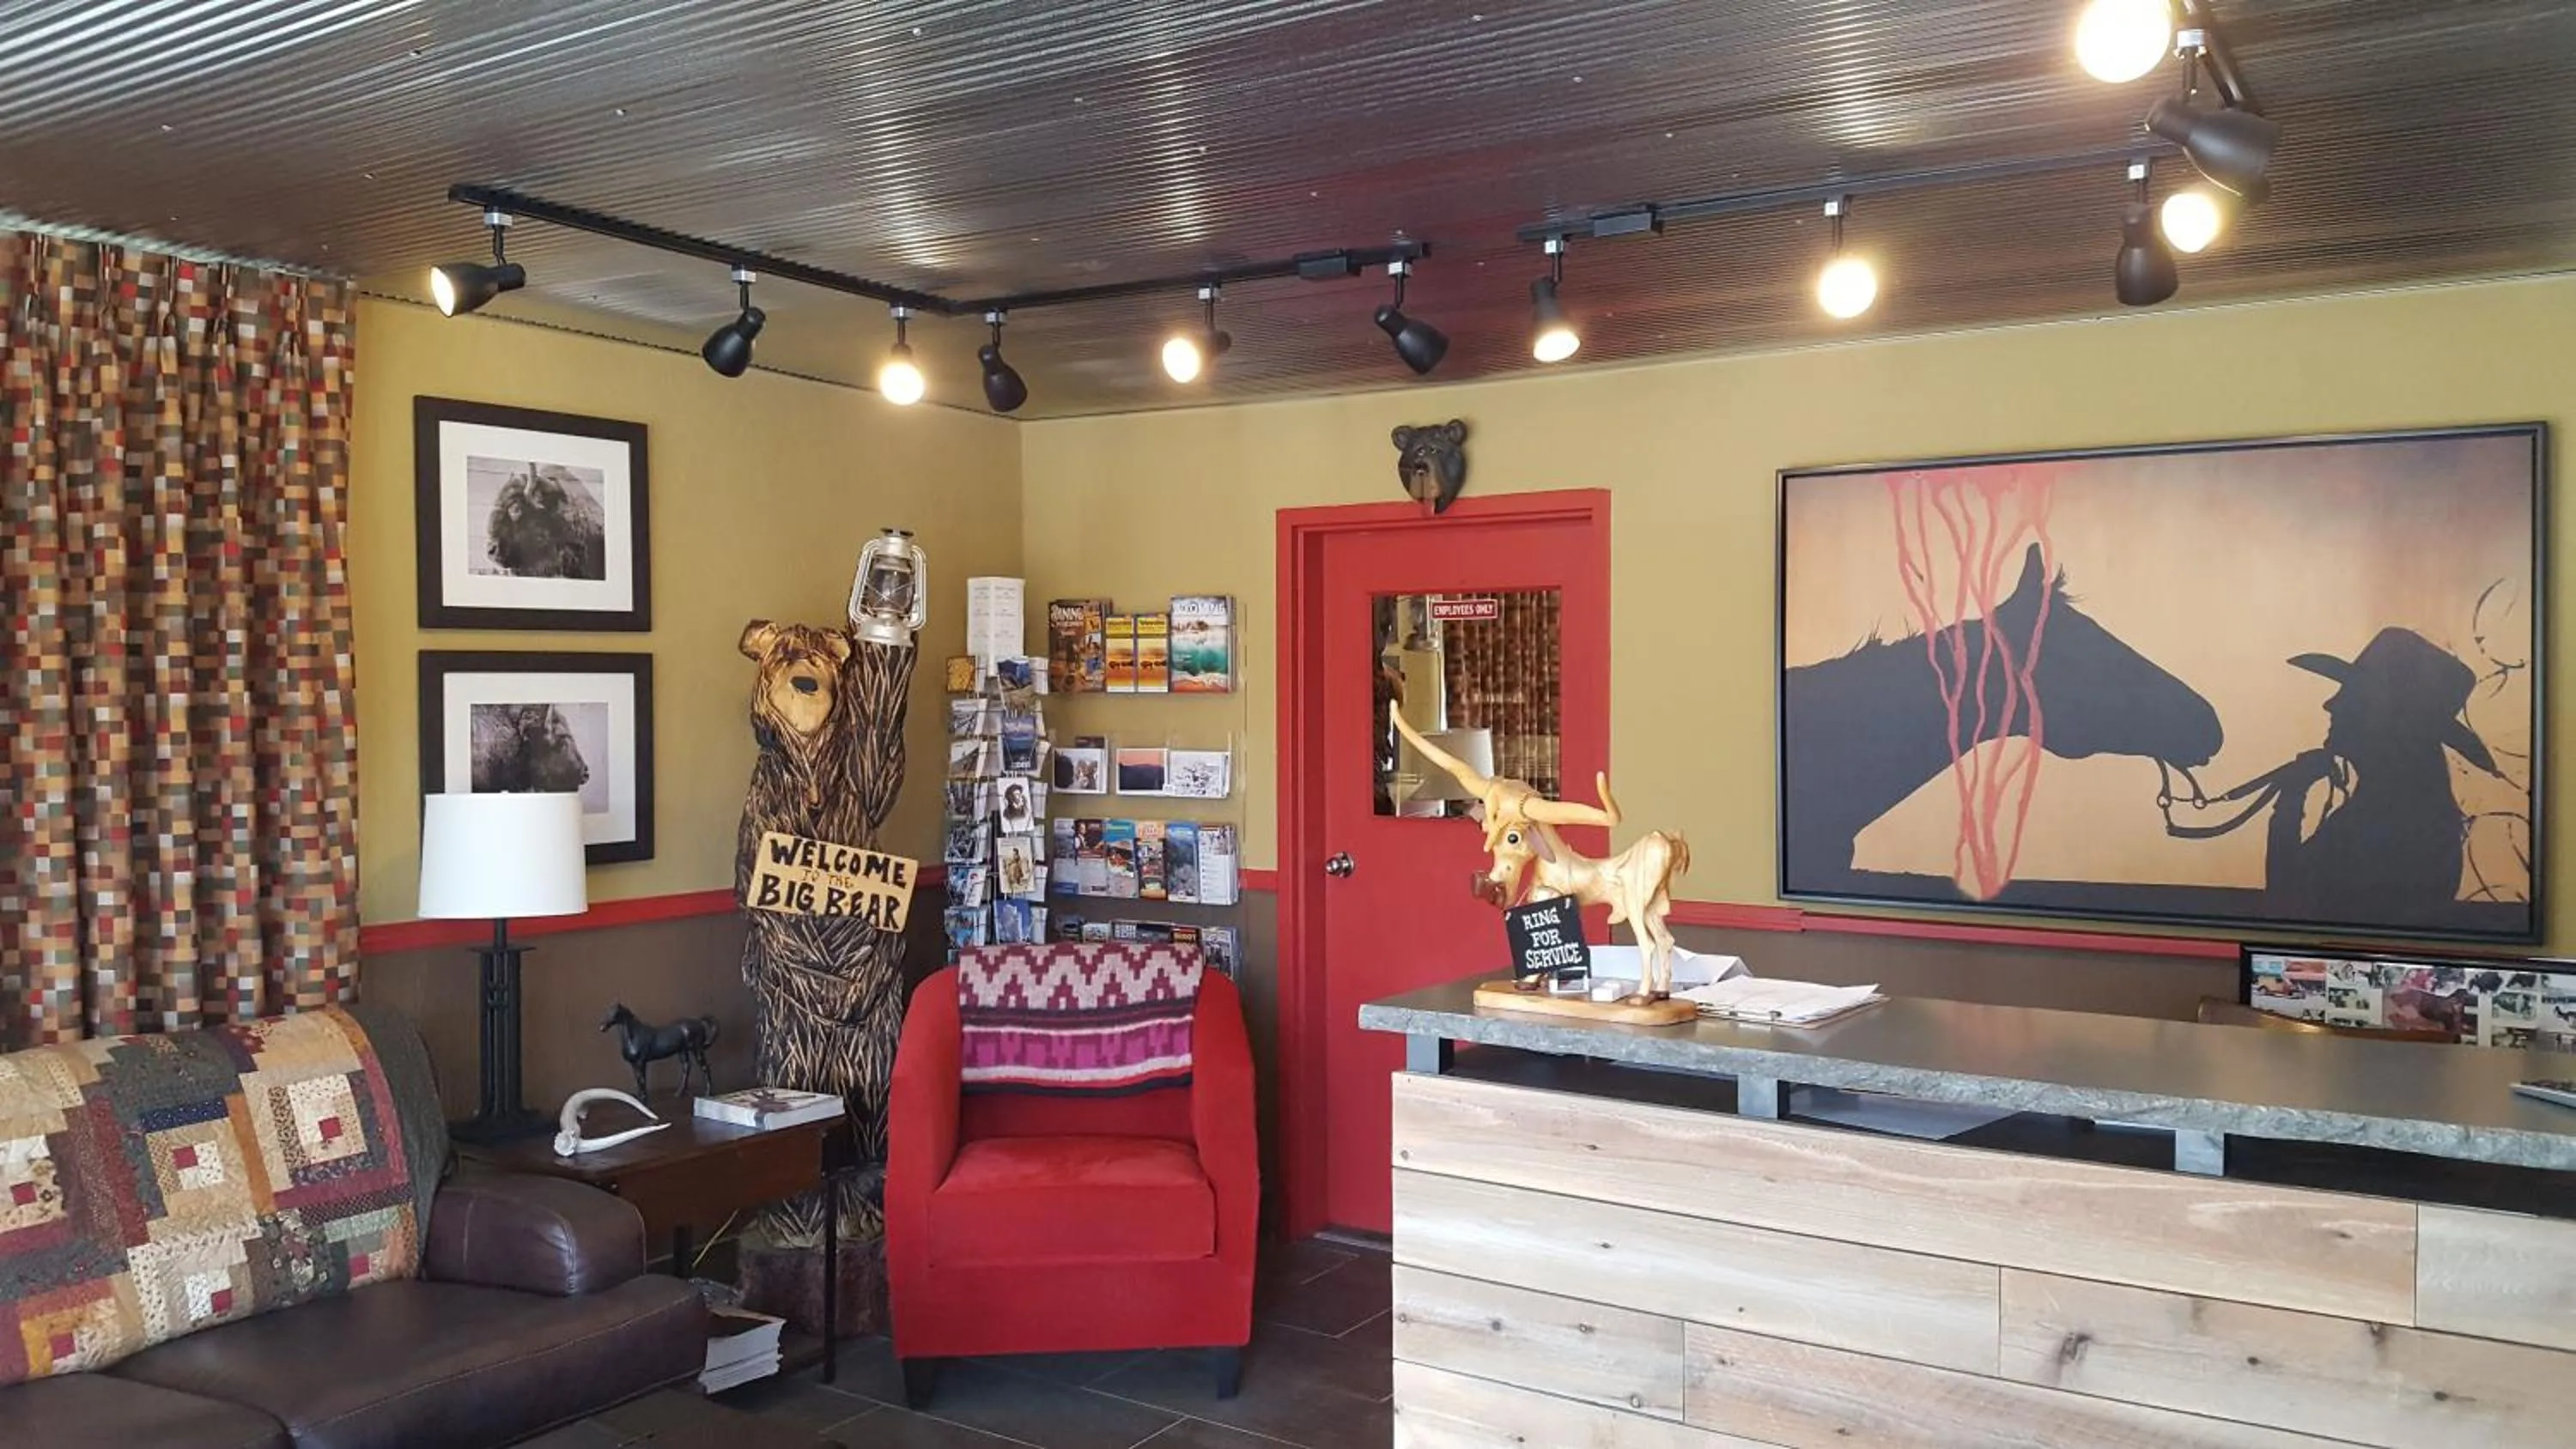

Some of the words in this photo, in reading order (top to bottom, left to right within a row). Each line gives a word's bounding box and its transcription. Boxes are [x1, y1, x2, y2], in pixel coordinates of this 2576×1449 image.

[1435, 604, 1473, 615] EMPLOYEES
[1476, 603, 1492, 614] ONLY
[769, 838, 907, 889] WELCOME
[803, 868, 819, 882] TO
[757, 873, 816, 915] BIG
[823, 886, 901, 930] BEAR
[1522, 906, 1561, 931] RING
[1531, 929, 1562, 947] FOR
[1525, 943, 1583, 968] SERVICE
